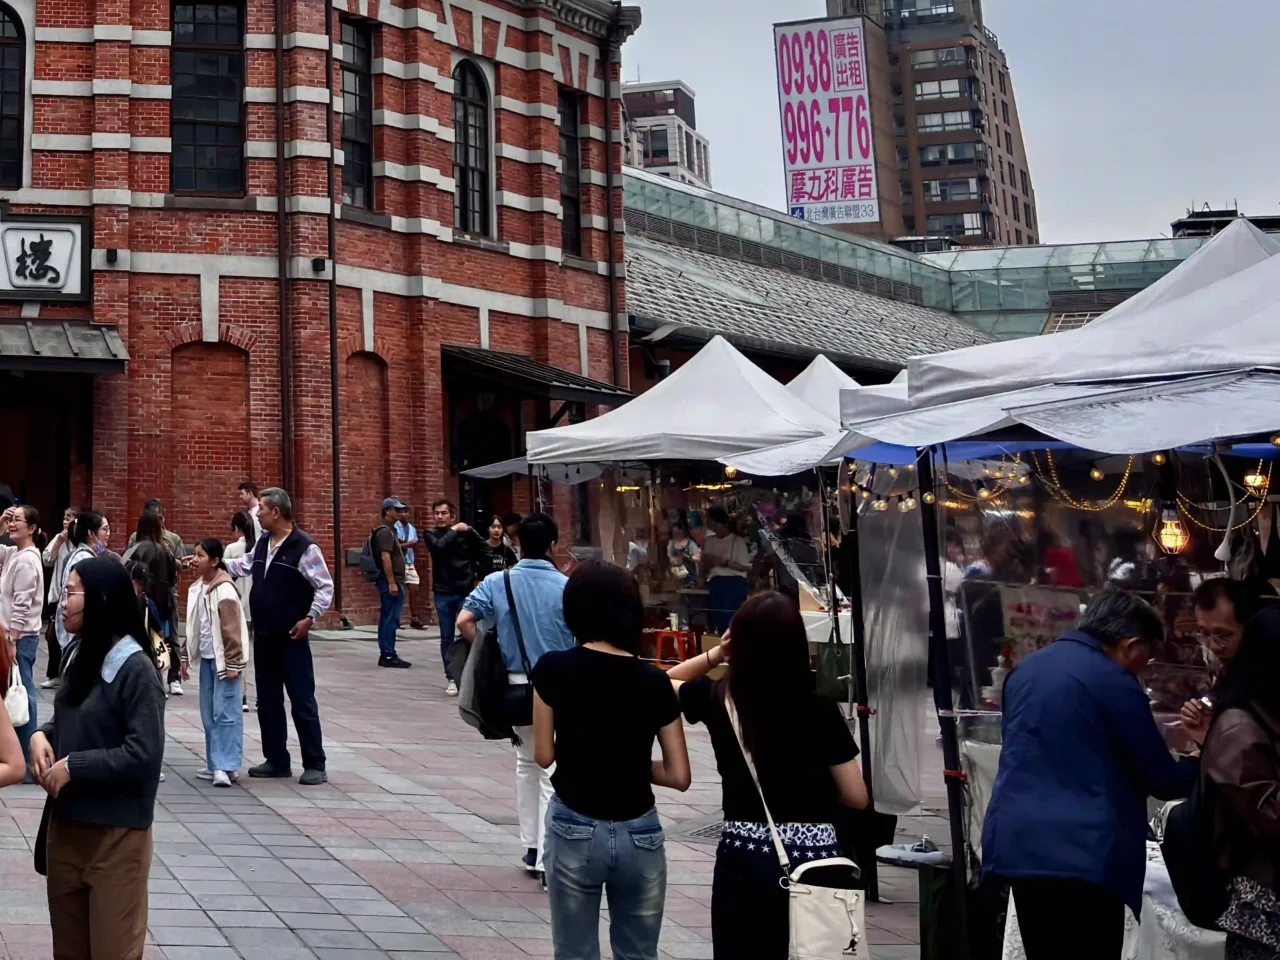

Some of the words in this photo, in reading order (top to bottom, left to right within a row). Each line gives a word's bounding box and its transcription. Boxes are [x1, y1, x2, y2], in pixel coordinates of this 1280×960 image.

[833, 32, 860, 59] 廣告
[779, 29, 831, 95] 0938
[836, 60, 862, 88] 出租
